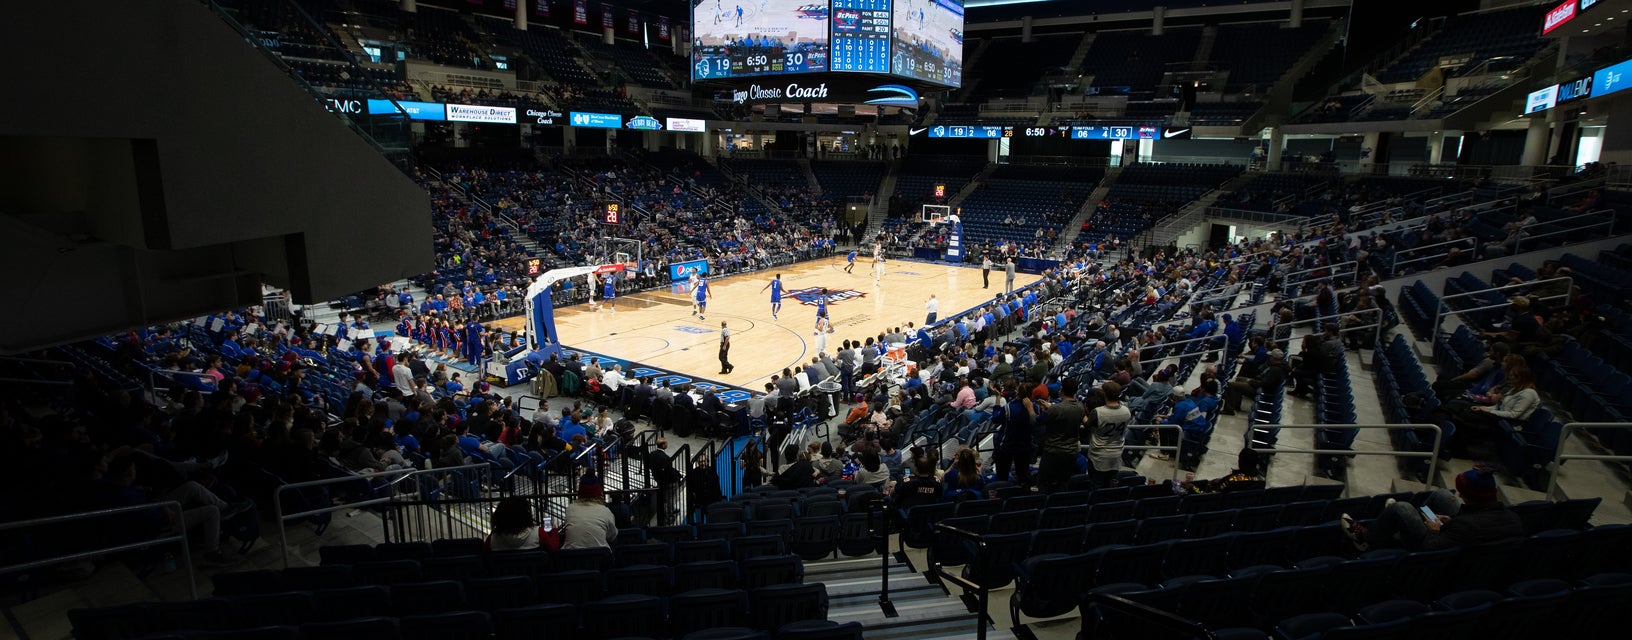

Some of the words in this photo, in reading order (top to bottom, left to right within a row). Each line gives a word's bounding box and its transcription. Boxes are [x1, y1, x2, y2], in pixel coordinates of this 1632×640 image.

[716, 58, 730, 70] 19
[746, 56, 767, 66] 6:50
[786, 53, 803, 66] 30
[906, 58, 914, 70] 19
[944, 67, 952, 78] 30
[750, 84, 781, 100] Classic
[786, 82, 828, 98] Coach
[527, 110, 546, 118] Chicago
[1026, 128, 1045, 136] 6:50
[1115, 129, 1127, 137] 30
[607, 211, 616, 222] 28
[1104, 422, 1126, 437] 24
